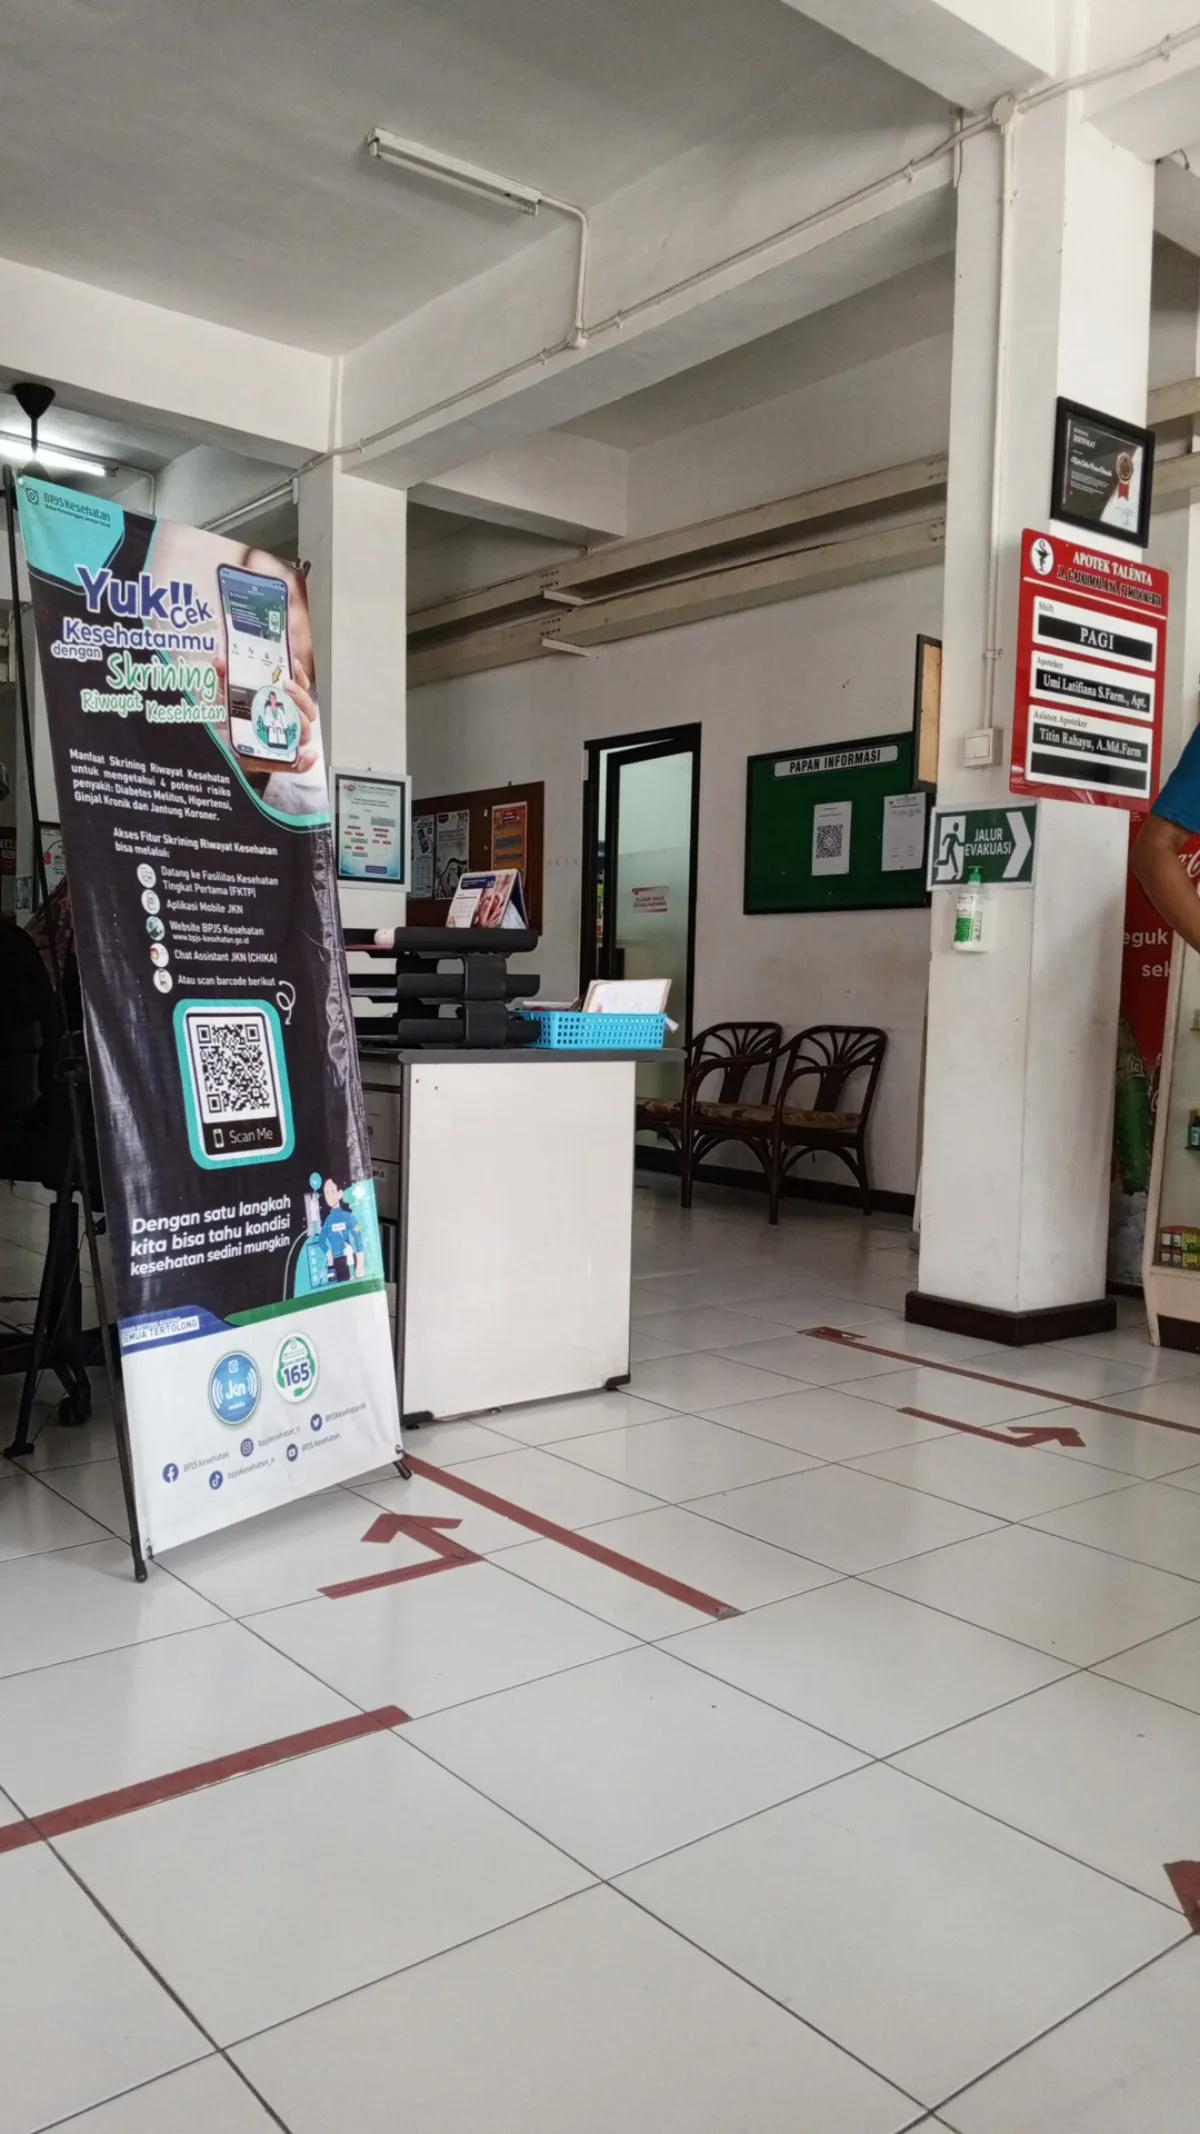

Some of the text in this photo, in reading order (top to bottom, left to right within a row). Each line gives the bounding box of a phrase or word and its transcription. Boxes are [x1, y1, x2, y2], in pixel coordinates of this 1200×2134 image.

[44, 492, 65, 508] BPJS
[65, 500, 111, 522] Kesehatan
[1073, 551, 1111, 574] APOTEK
[75, 565, 193, 619] Yuk!!
[170, 598, 213, 630] Cek
[1039, 601, 1054, 613] Shift
[65, 618, 215, 651] Kesehatanmu
[1080, 627, 1114, 650] PAGI
[53, 641, 217, 700] dengan Skrining
[1037, 657, 1064, 669] Apoteker
[1043, 673, 1061, 689] Umi
[1062, 678, 1097, 697] Latifiana
[1131, 694, 1147, 709] Apt.
[82, 689, 226, 723] Riwayat Kesehatan
[1033, 710, 1087, 728] Asisten Apoteker
[1039, 727, 1060, 742] Titin
[1062, 731, 1095, 751] Rahayu,
[70, 749, 230, 784] Manfaat Skrining Riwayat Kesehatan
[790, 749, 881, 773] PAPAN INFORMASI
[71, 764, 231, 797] untuk mengetahui 4 potensi risiko
[73, 778, 232, 811] penyakit: Diabetes Melitus, Hipertensi,
[74, 791, 219, 821] Ginjal Kronik dan Jantung Koroner.
[113, 827, 278, 856] Akses Fitur Skrining Riwayat Kesehatan
[974, 828, 1003, 842] JALUR
[115, 841, 170, 857] bisa melalui:
[965, 841, 1011, 856] EVAKUASI
[161, 866, 279, 886] Datang ke Fasilitas Kesehatan
[162, 880, 256, 898] Tingkat Pertama (FKTP)
[167, 900, 243, 914] Aplikasi Mobile JKN
[169, 920, 264, 937] Website BPJS Kesehatan
[174, 949, 278, 964] Chat Assistant JKN (CHIKA)
[178, 975, 275, 986] Atau scan barcode berikut
[229, 1127, 273, 1144] Scan Me
[131, 1194, 291, 1234] Dengan satu langkah
[131, 1214, 291, 1257] kita bisa tahu kondisi
[130, 1233, 290, 1276] kesehatan sedini mungkin
[149, 1318, 198, 1337] TERTOLONG
[283, 1362, 310, 1386] 165
[302, 1441, 313, 1452] BPJS
[183, 1452, 229, 1472] BPJS Kesehatan
